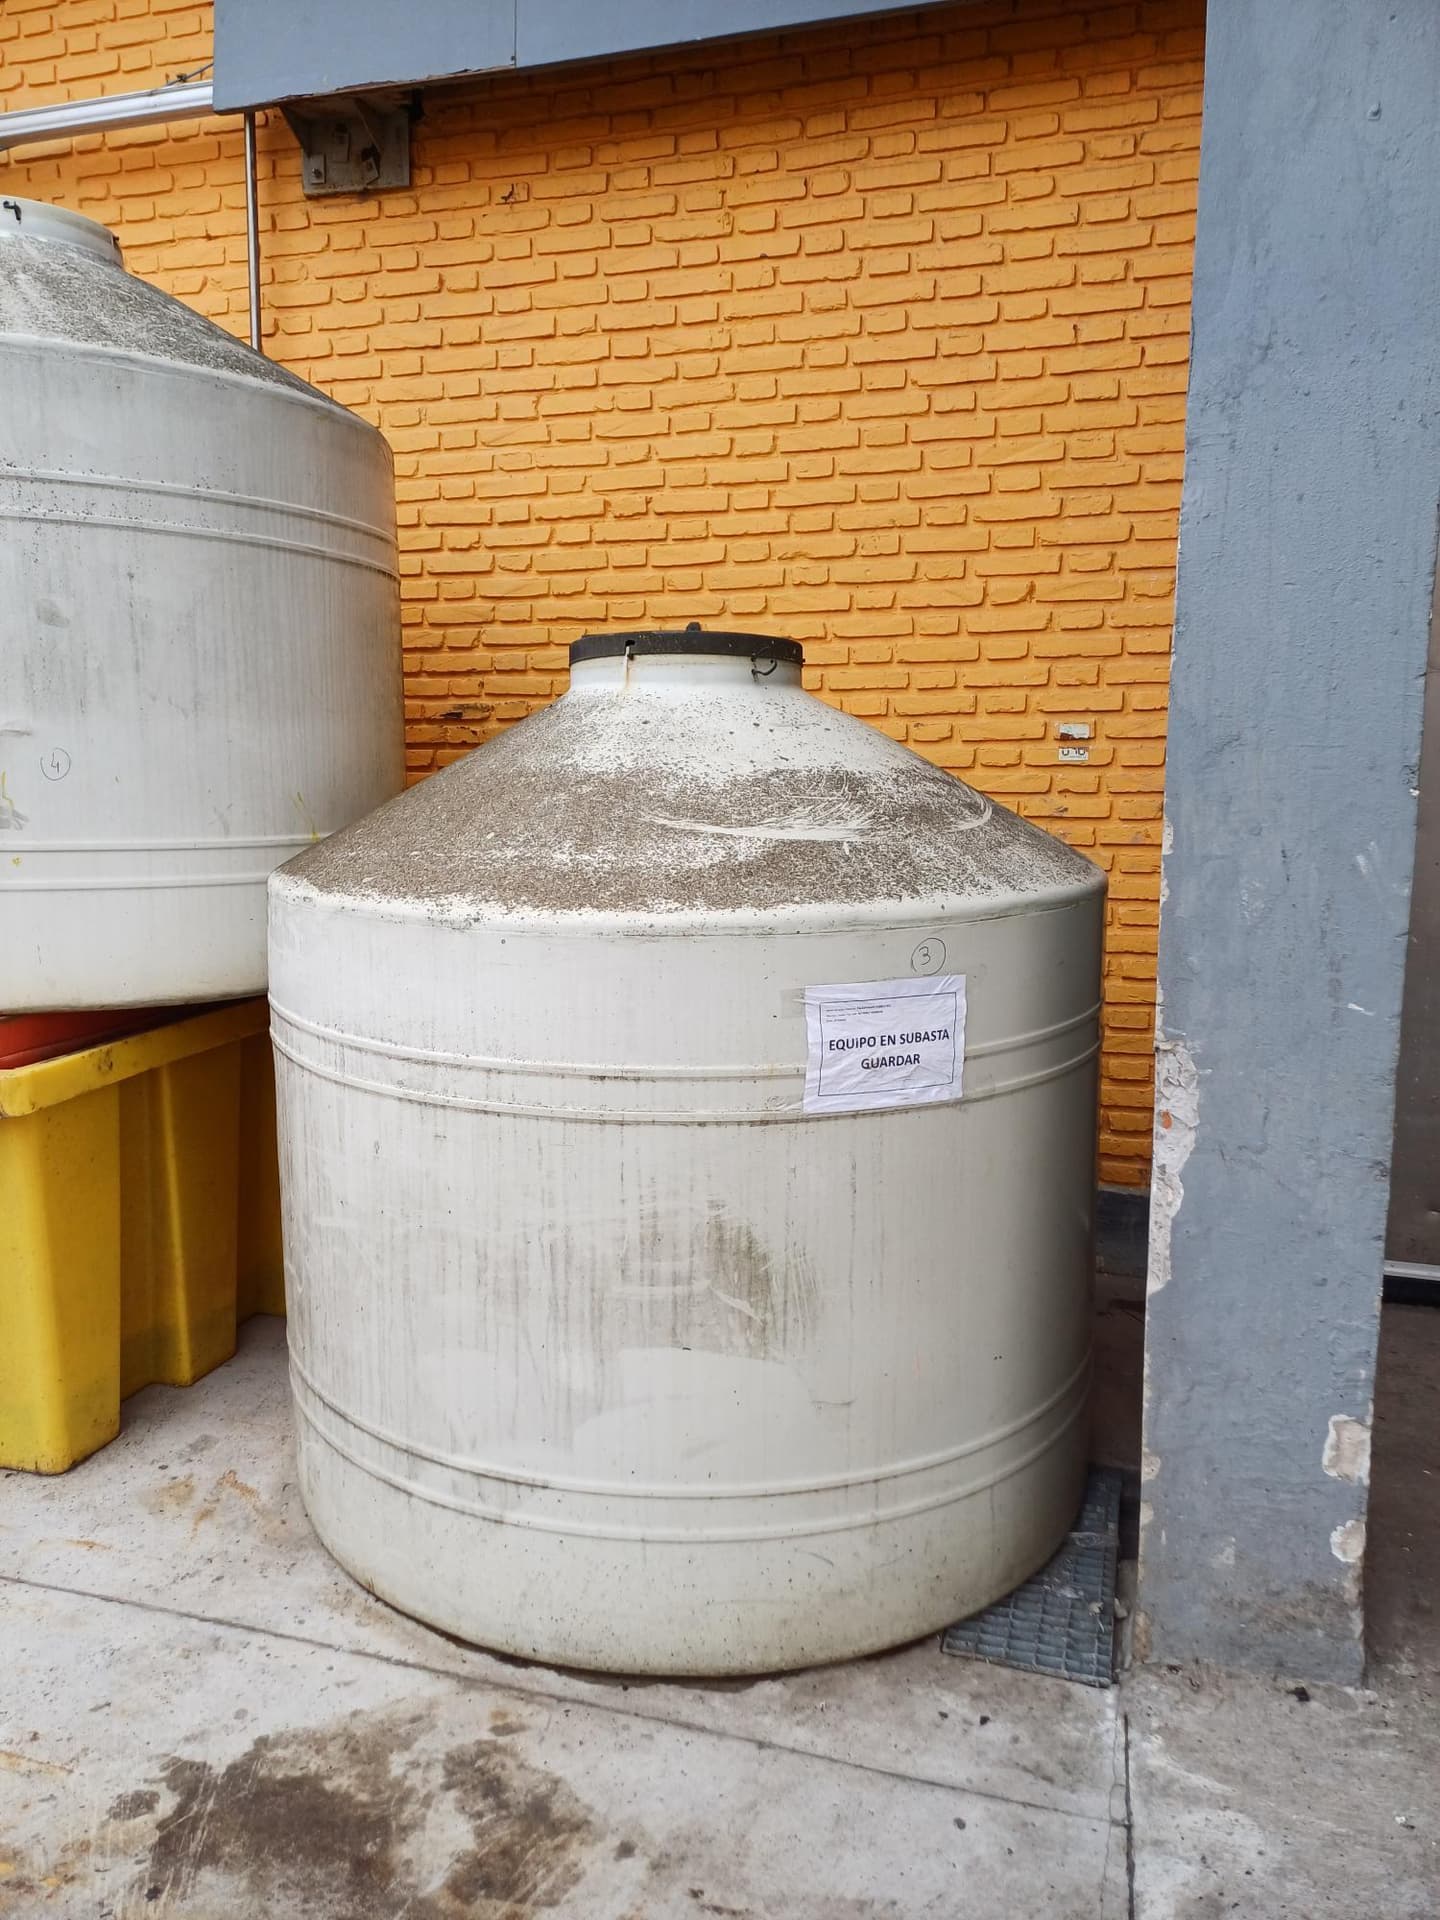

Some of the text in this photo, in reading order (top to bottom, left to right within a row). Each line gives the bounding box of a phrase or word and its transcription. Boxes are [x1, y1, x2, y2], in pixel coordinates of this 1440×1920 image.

[918, 946, 931, 966] 3
[880, 1034, 896, 1046] EN
[900, 1029, 950, 1045] SUBASTA
[861, 1053, 921, 1070] GUARDAR
